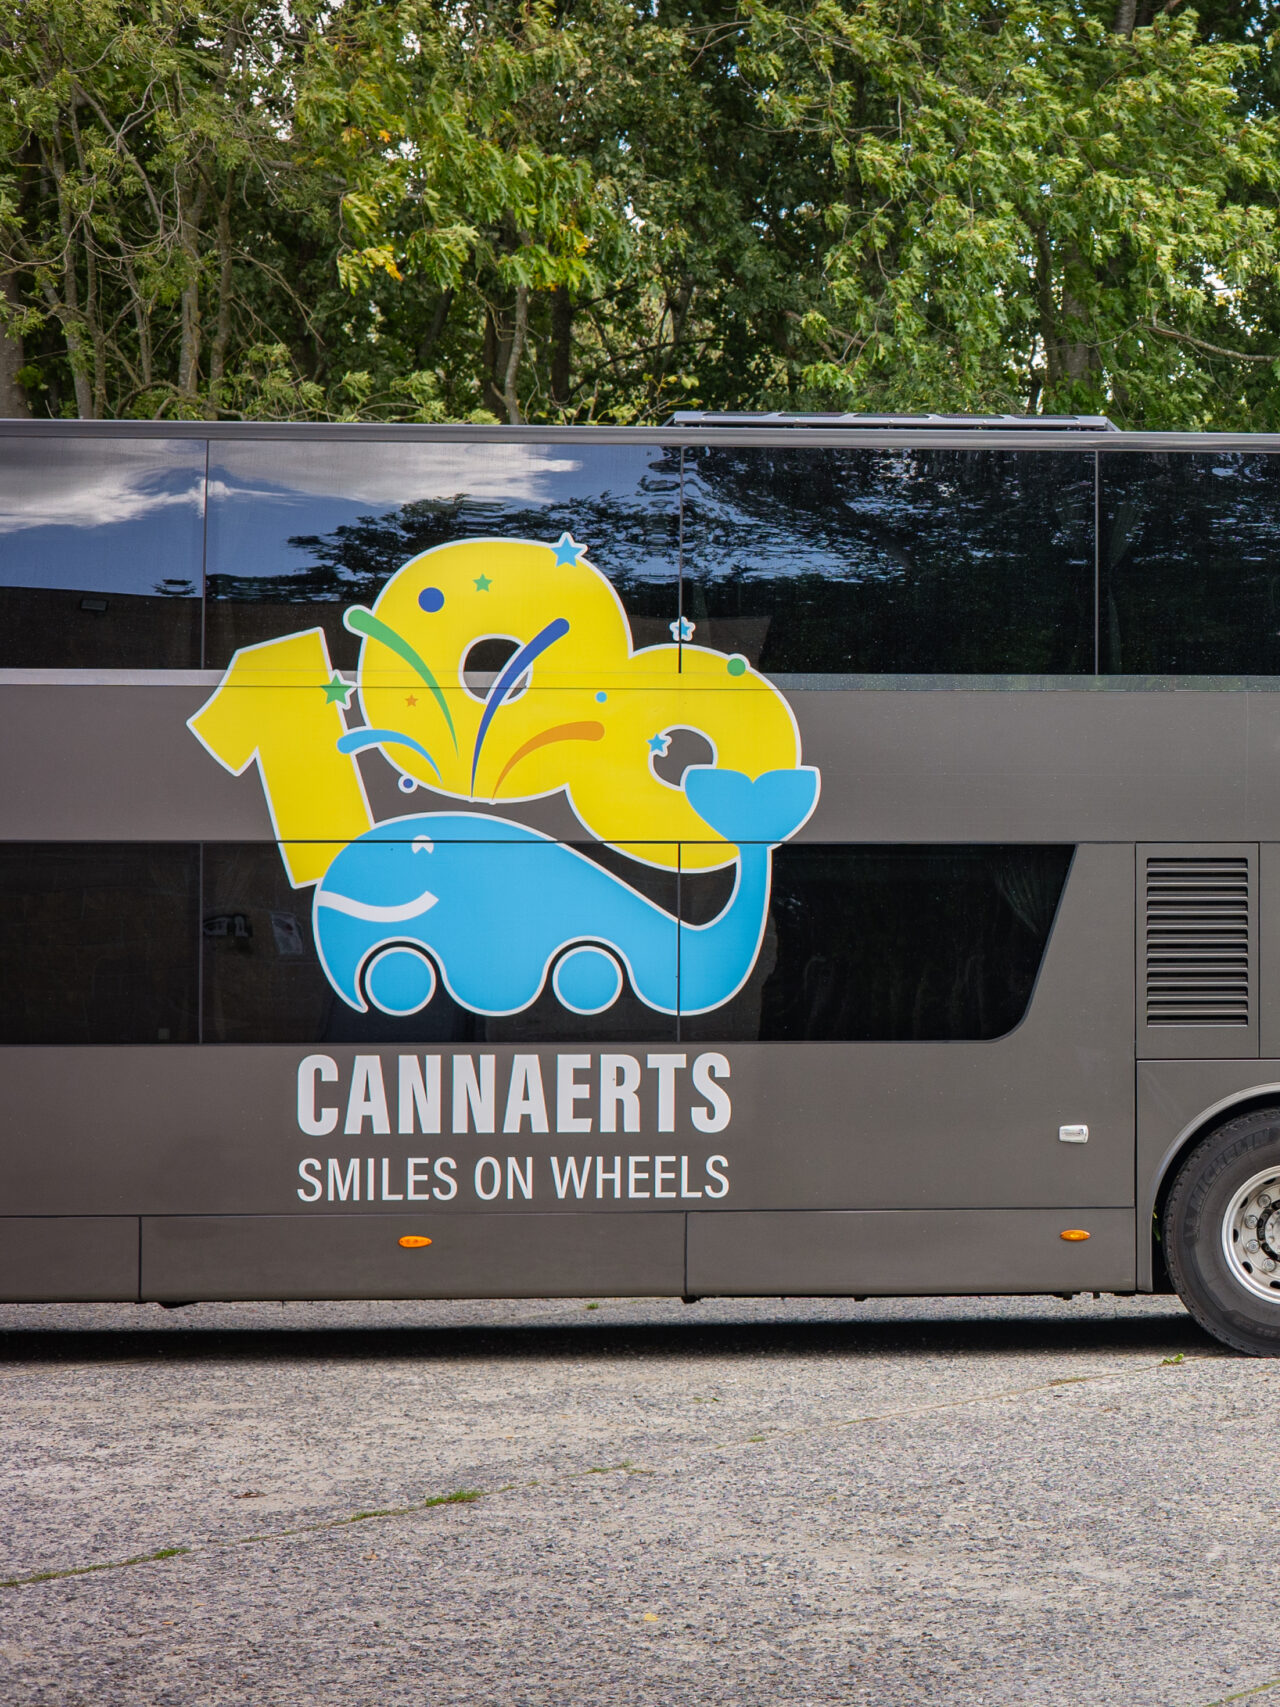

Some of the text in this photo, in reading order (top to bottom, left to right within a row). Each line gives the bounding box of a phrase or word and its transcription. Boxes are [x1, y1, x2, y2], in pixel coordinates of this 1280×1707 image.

[298, 1052, 732, 1136] CANNAERTS
[298, 1155, 730, 1202] SMILES ON WHEELS
[1190, 1128, 1270, 1208] MICHELIN
